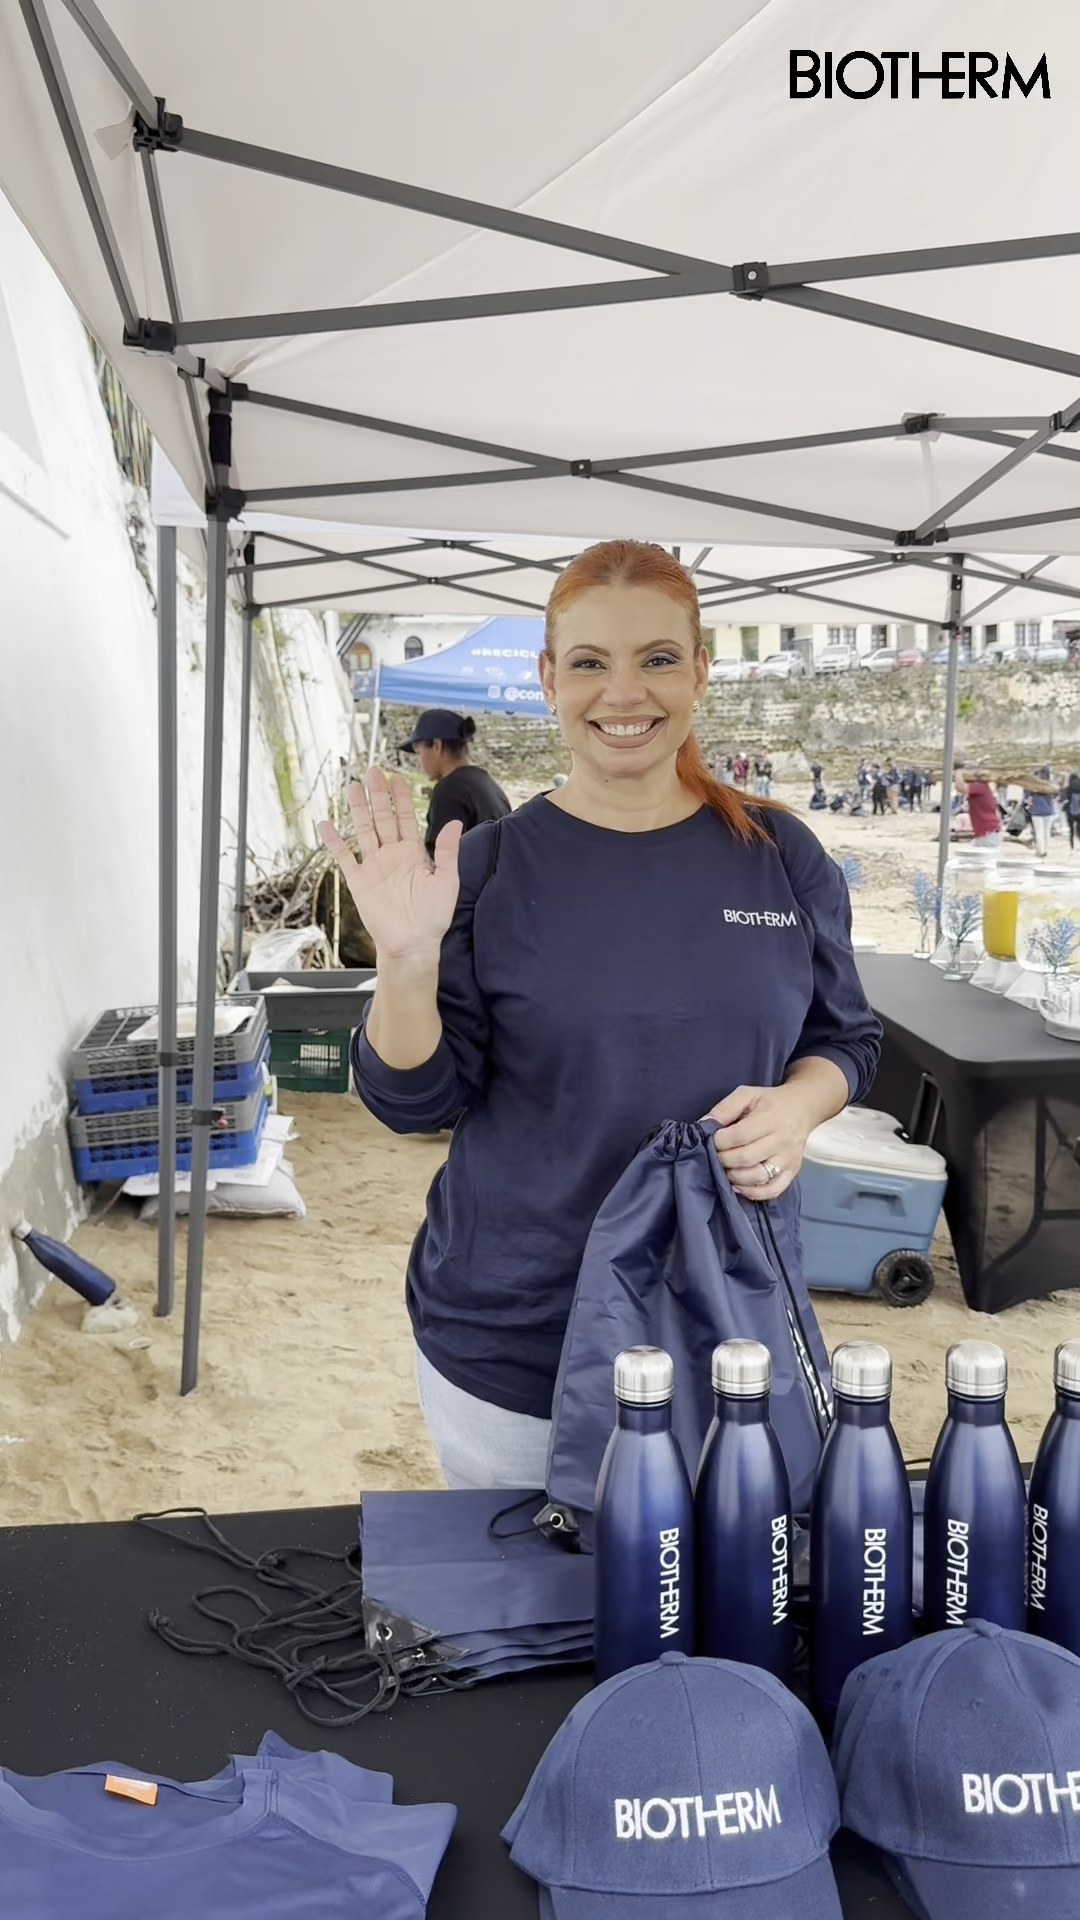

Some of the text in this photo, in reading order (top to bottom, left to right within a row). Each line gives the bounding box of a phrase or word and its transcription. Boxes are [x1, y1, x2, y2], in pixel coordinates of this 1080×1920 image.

[723, 909, 797, 927] BIOTHERM
[659, 1527, 680, 1639] BIOTHERM
[771, 1514, 788, 1625] BIOTHERM
[862, 1528, 887, 1635] BIOTHERM
[946, 1518, 969, 1625] BIOTHERM
[1031, 1503, 1049, 1611] BIOTHERM
[614, 1785, 782, 1839] BIOTHERM
